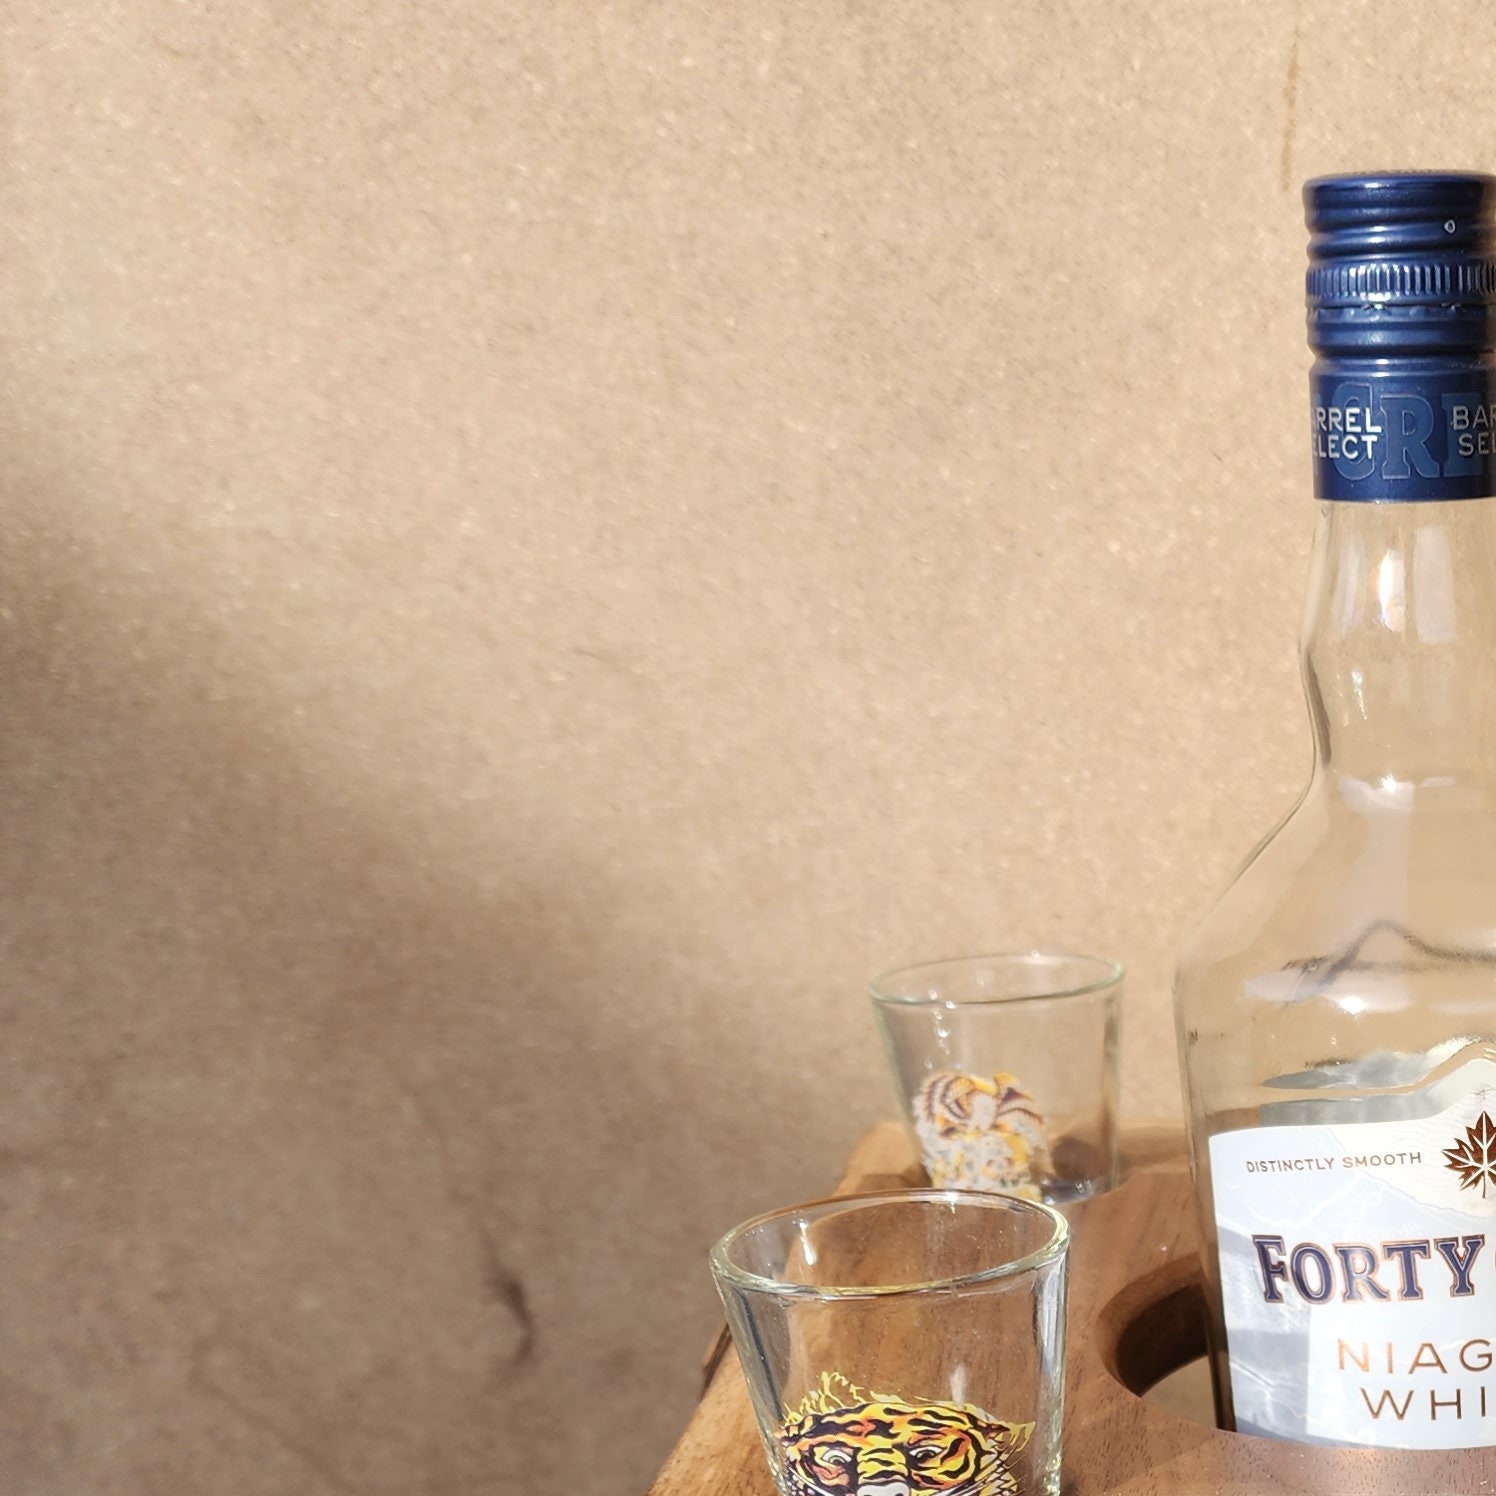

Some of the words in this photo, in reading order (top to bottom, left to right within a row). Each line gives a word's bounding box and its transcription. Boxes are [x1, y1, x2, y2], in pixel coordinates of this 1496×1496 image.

[1312, 406, 1382, 433] RREL
[1246, 1157, 1335, 1173] DISTINCTLY
[1342, 1151, 1422, 1169] SMOOTH
[1252, 1234, 1486, 1304] FORTY
